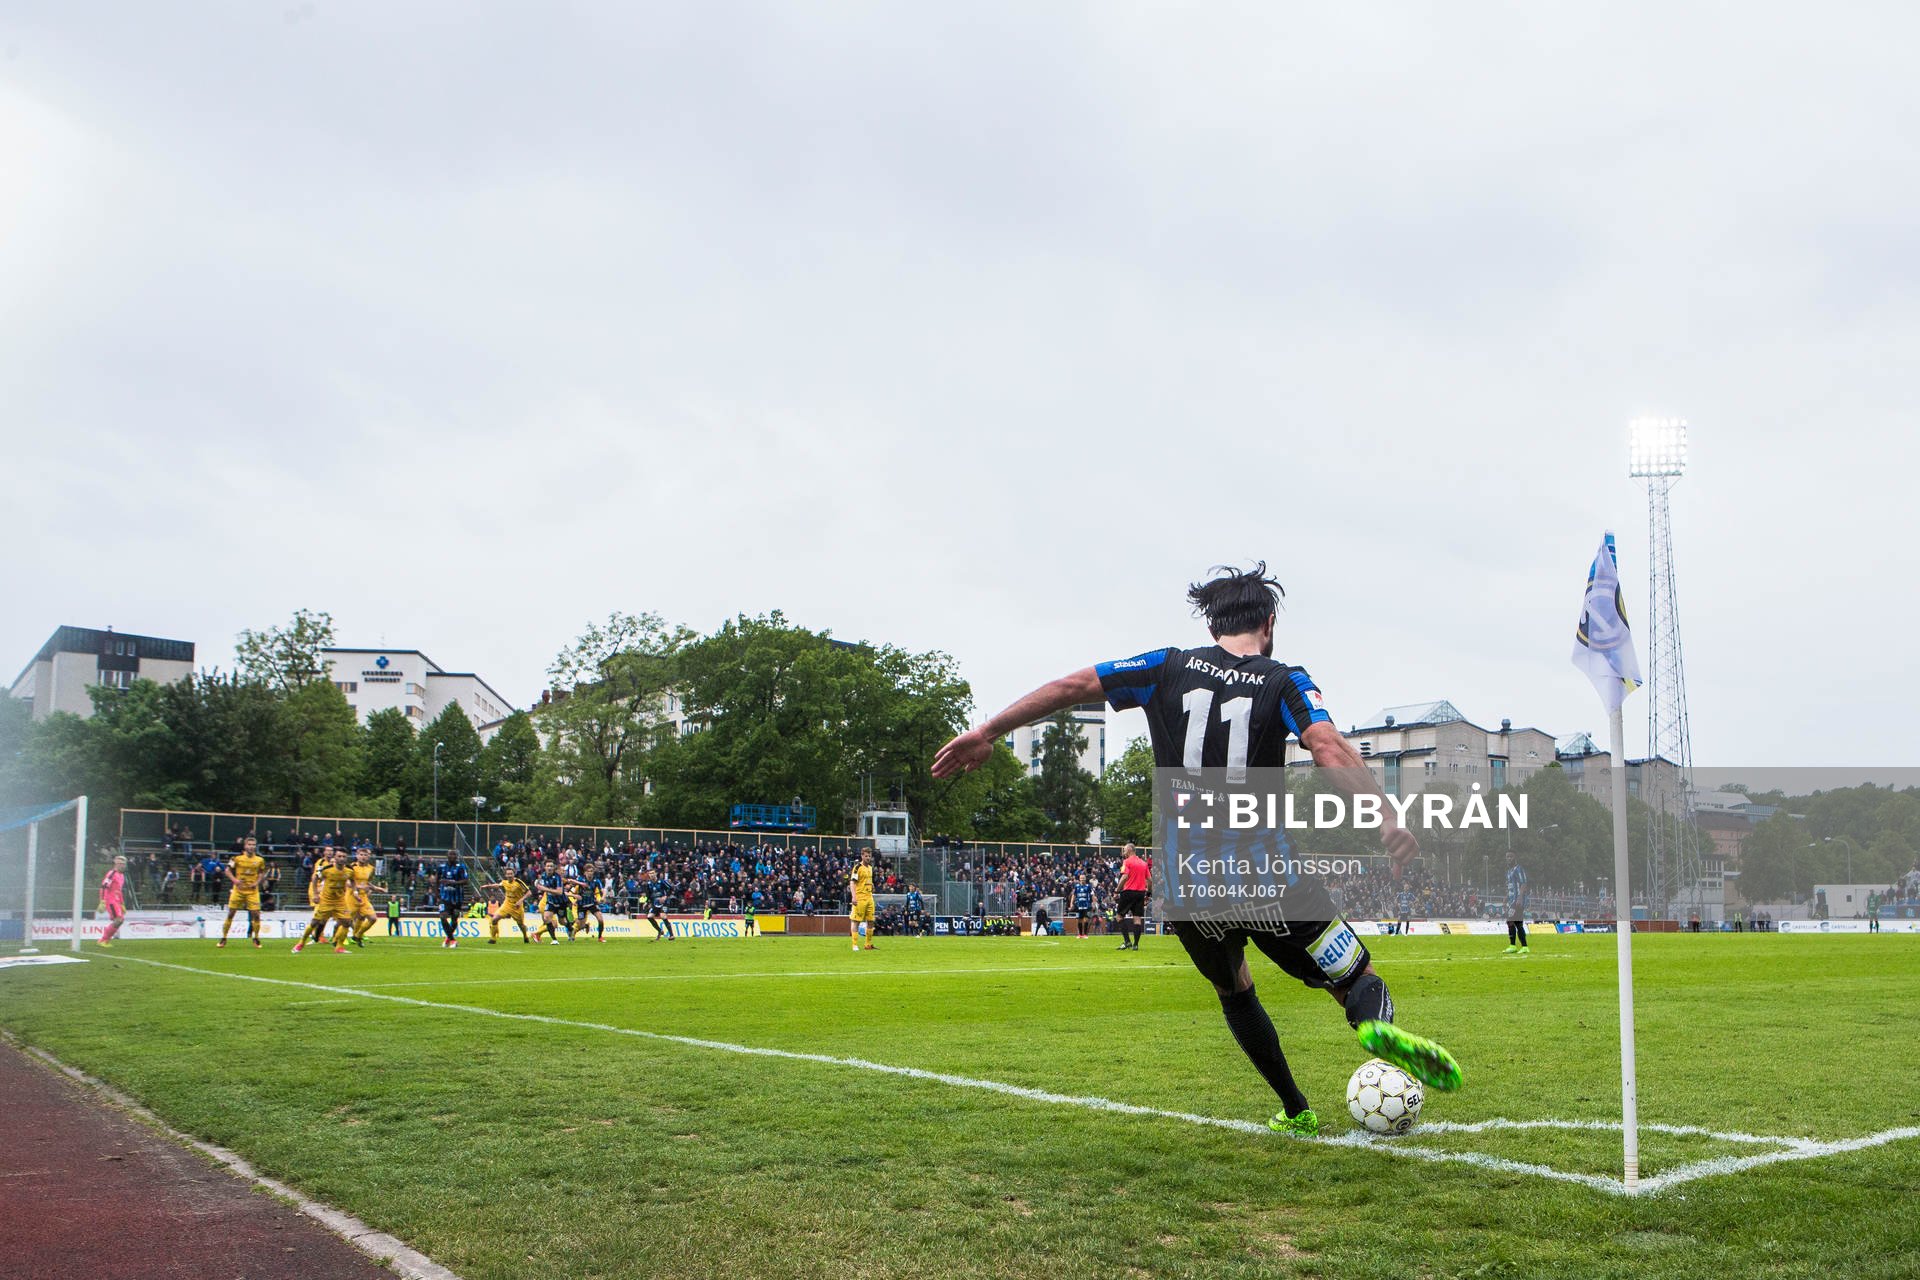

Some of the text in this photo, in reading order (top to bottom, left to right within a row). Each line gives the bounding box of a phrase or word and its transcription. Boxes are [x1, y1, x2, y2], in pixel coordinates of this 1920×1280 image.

[1185, 656, 1265, 685] ÅRSTA TAK
[1182, 687, 1253, 785] 11
[692, 922, 739, 938] GROSS
[1317, 929, 1354, 969] RELITA
